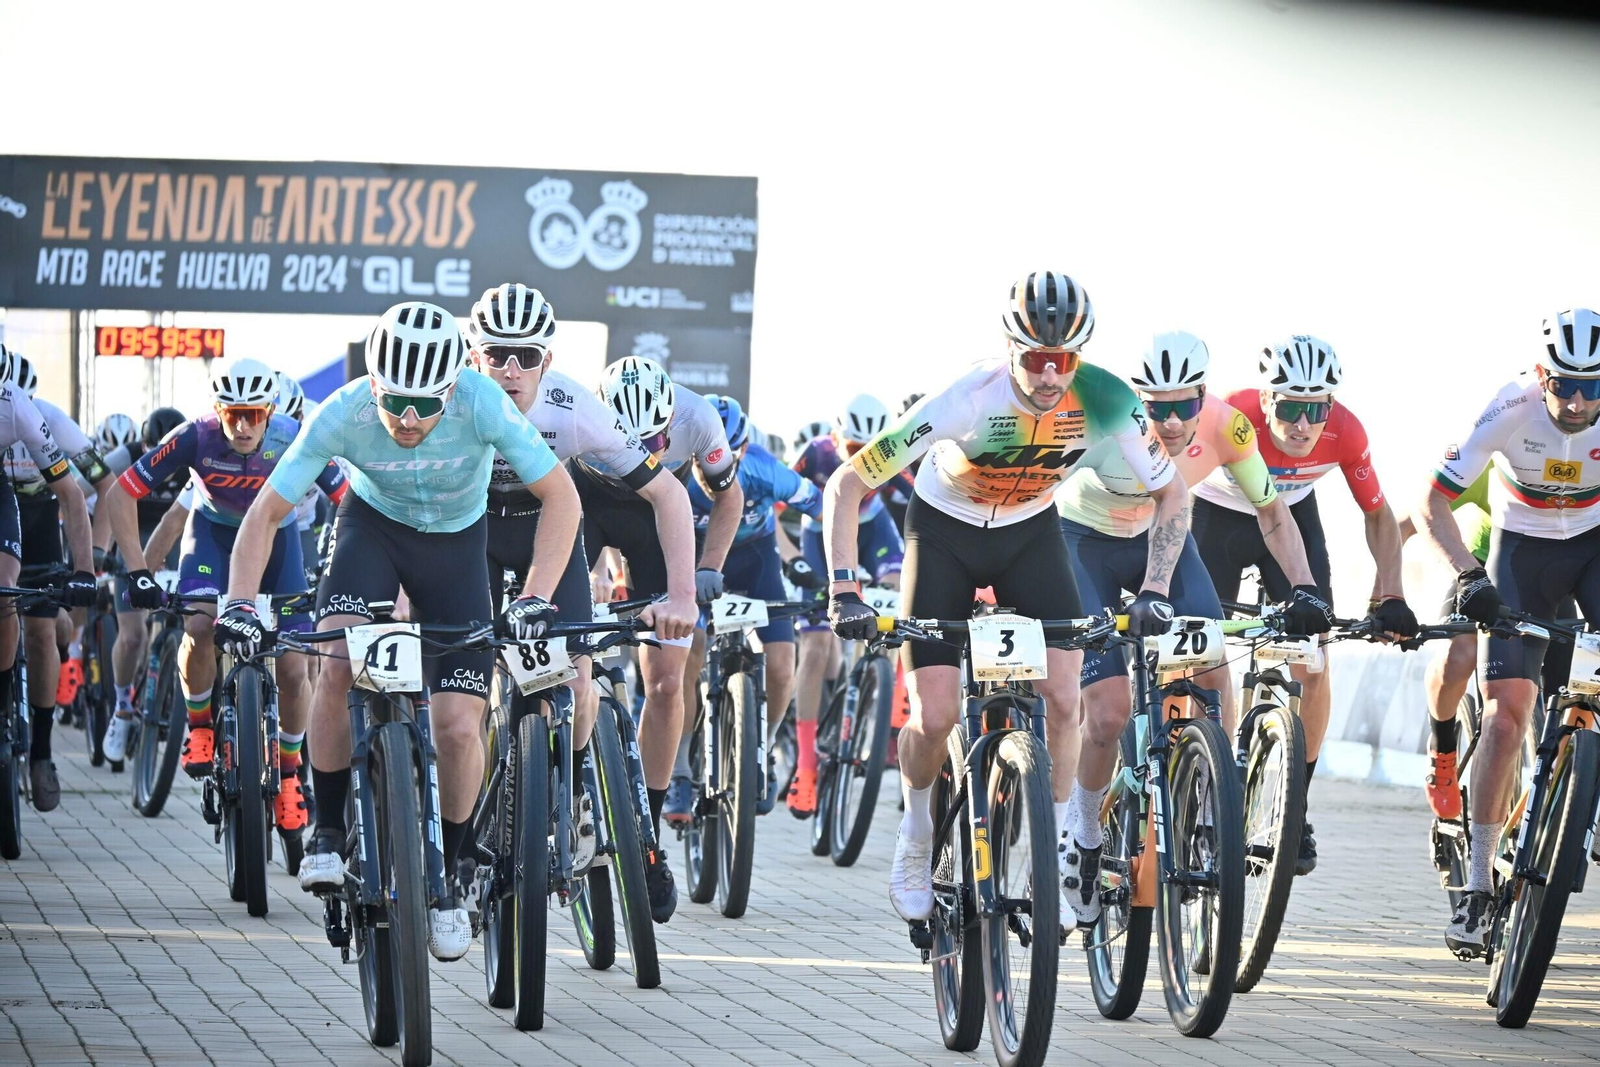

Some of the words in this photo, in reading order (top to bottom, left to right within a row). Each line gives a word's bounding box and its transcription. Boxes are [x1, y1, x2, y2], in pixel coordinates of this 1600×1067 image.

[46, 172, 68, 198] LA
[42, 172, 245, 243] LEYENDA
[256, 175, 477, 249] TARTESSOS
[252, 216, 274, 243] DE
[36, 248, 88, 286] MTB
[101, 250, 165, 289] RACE
[178, 253, 270, 291] HUELVA
[282, 255, 348, 293] 2024
[615, 285, 660, 308] UCI
[363, 456, 469, 471] SCOTT
[969, 445, 1087, 469] KTM
[204, 473, 266, 490] DM
[979, 471, 1062, 481] KOMETA
[320, 602, 375, 619] BANDIDA
[330, 594, 365, 606] CALA
[725, 602, 752, 617] 27
[998, 630, 1015, 657] 3
[1173, 631, 1208, 655] 20
[518, 640, 550, 671] 88
[454, 668, 484, 682] CALA
[441, 679, 488, 696] BANDIDA
